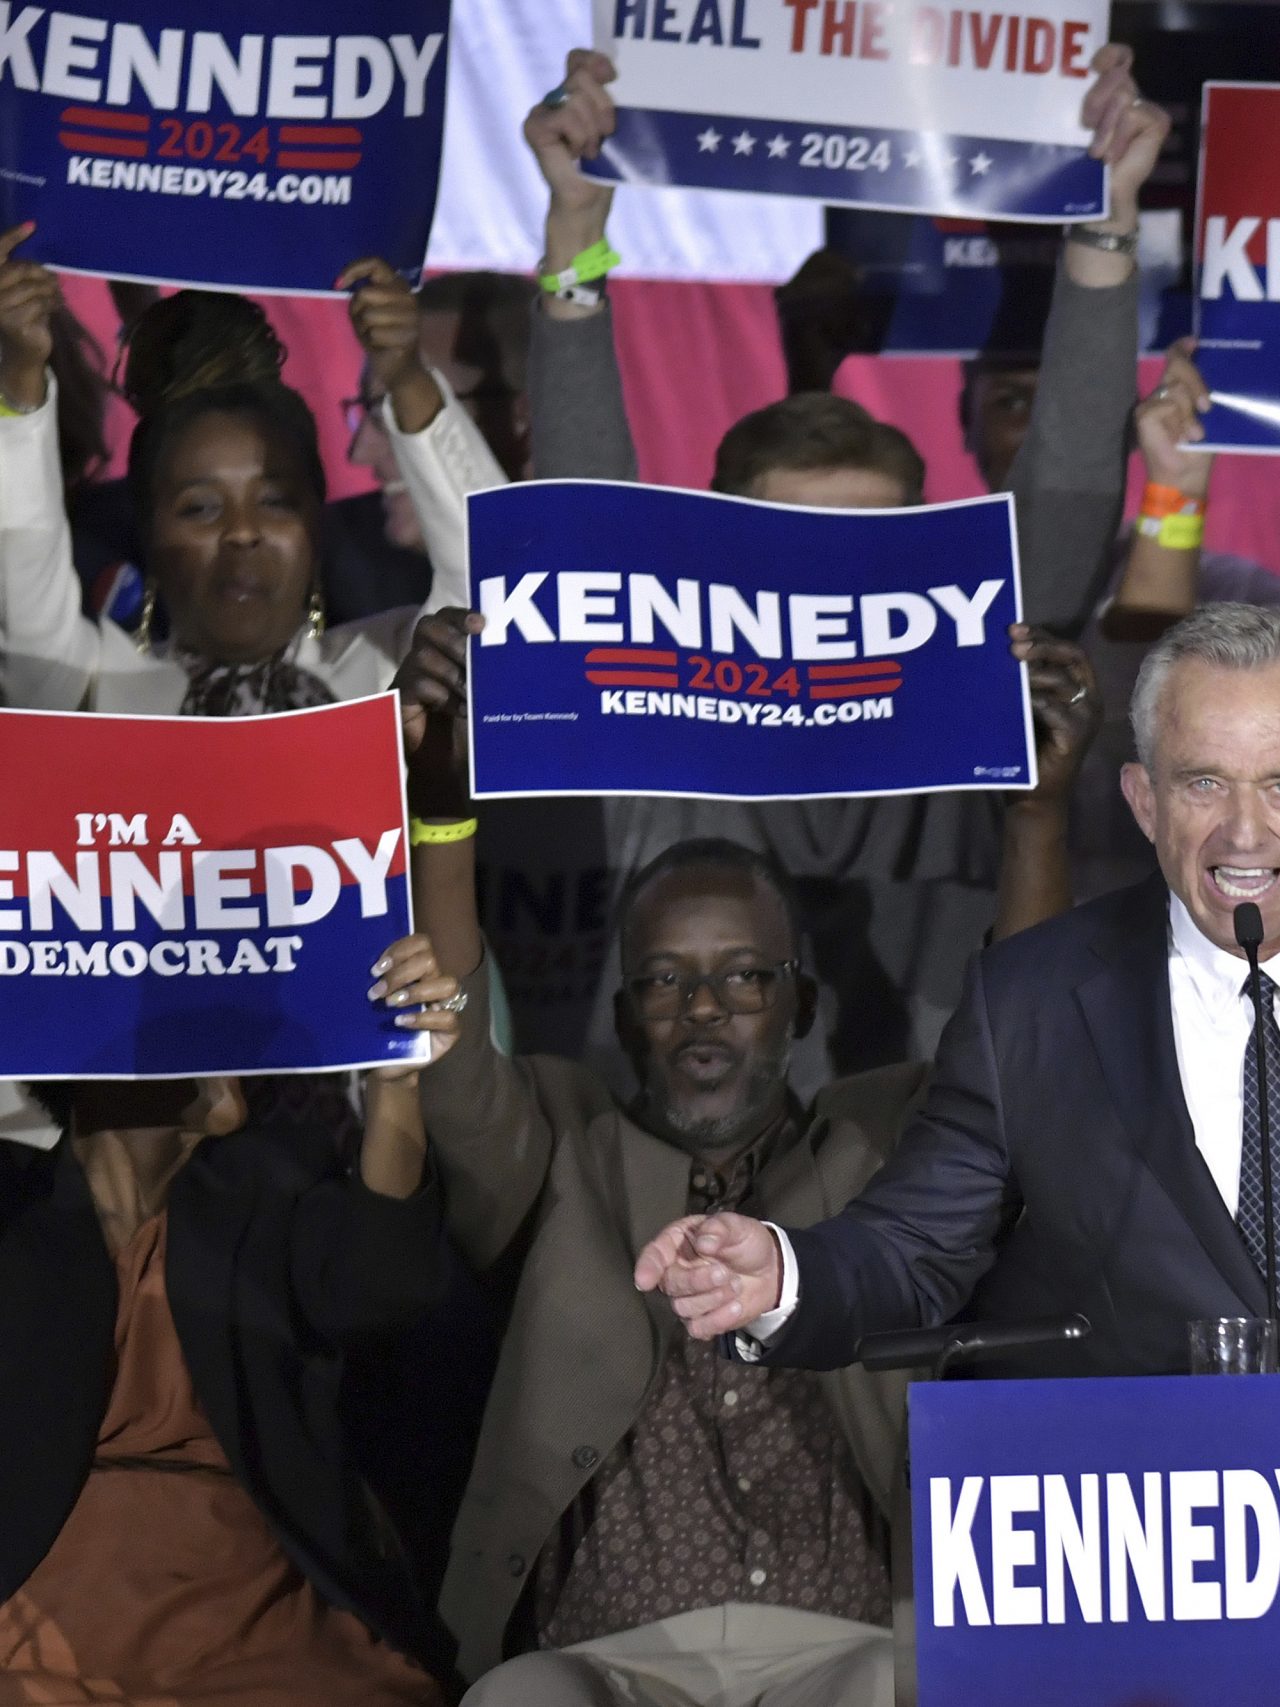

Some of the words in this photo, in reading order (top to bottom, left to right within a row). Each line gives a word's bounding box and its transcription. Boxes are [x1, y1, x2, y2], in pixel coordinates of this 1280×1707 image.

[613, 0, 760, 48] HEAL
[785, 0, 889, 60] THE
[0, 1, 444, 119] KENNEDY
[158, 119, 271, 164] 2024
[799, 132, 891, 172] 2024
[66, 156, 352, 205] KENNEDY24.COM
[479, 571, 1006, 660] KENNEDY
[687, 655, 801, 698] 2024
[600, 690, 894, 727] KENNEDY24.COM
[75, 812, 149, 846] I'M
[161, 813, 202, 846] A
[0, 936, 303, 977] DEMOCRAT
